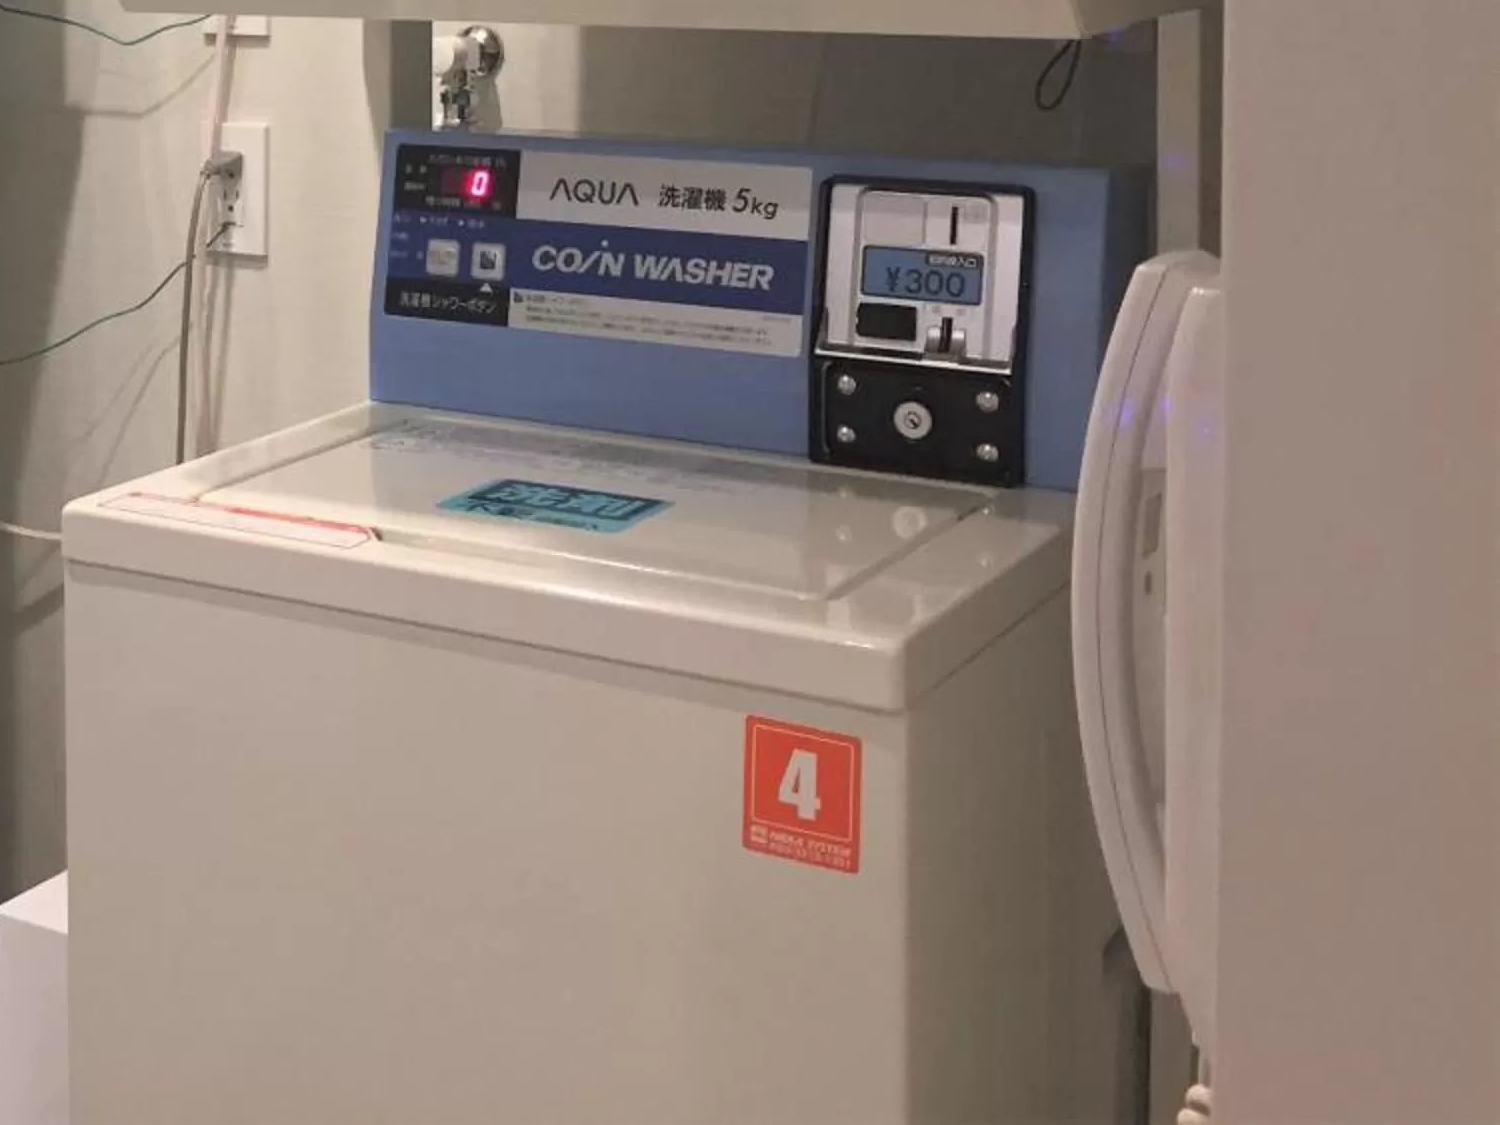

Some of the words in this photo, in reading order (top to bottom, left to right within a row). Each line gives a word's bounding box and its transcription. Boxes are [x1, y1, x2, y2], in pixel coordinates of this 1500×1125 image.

[471, 171, 489, 196] 0
[550, 178, 640, 206] AQUA
[659, 183, 727, 211] 洗濯機
[732, 188, 779, 220] 5kg
[531, 239, 624, 277] COIN
[633, 254, 775, 290] WASHER
[885, 266, 965, 298] ¥300
[778, 748, 821, 821] 4
